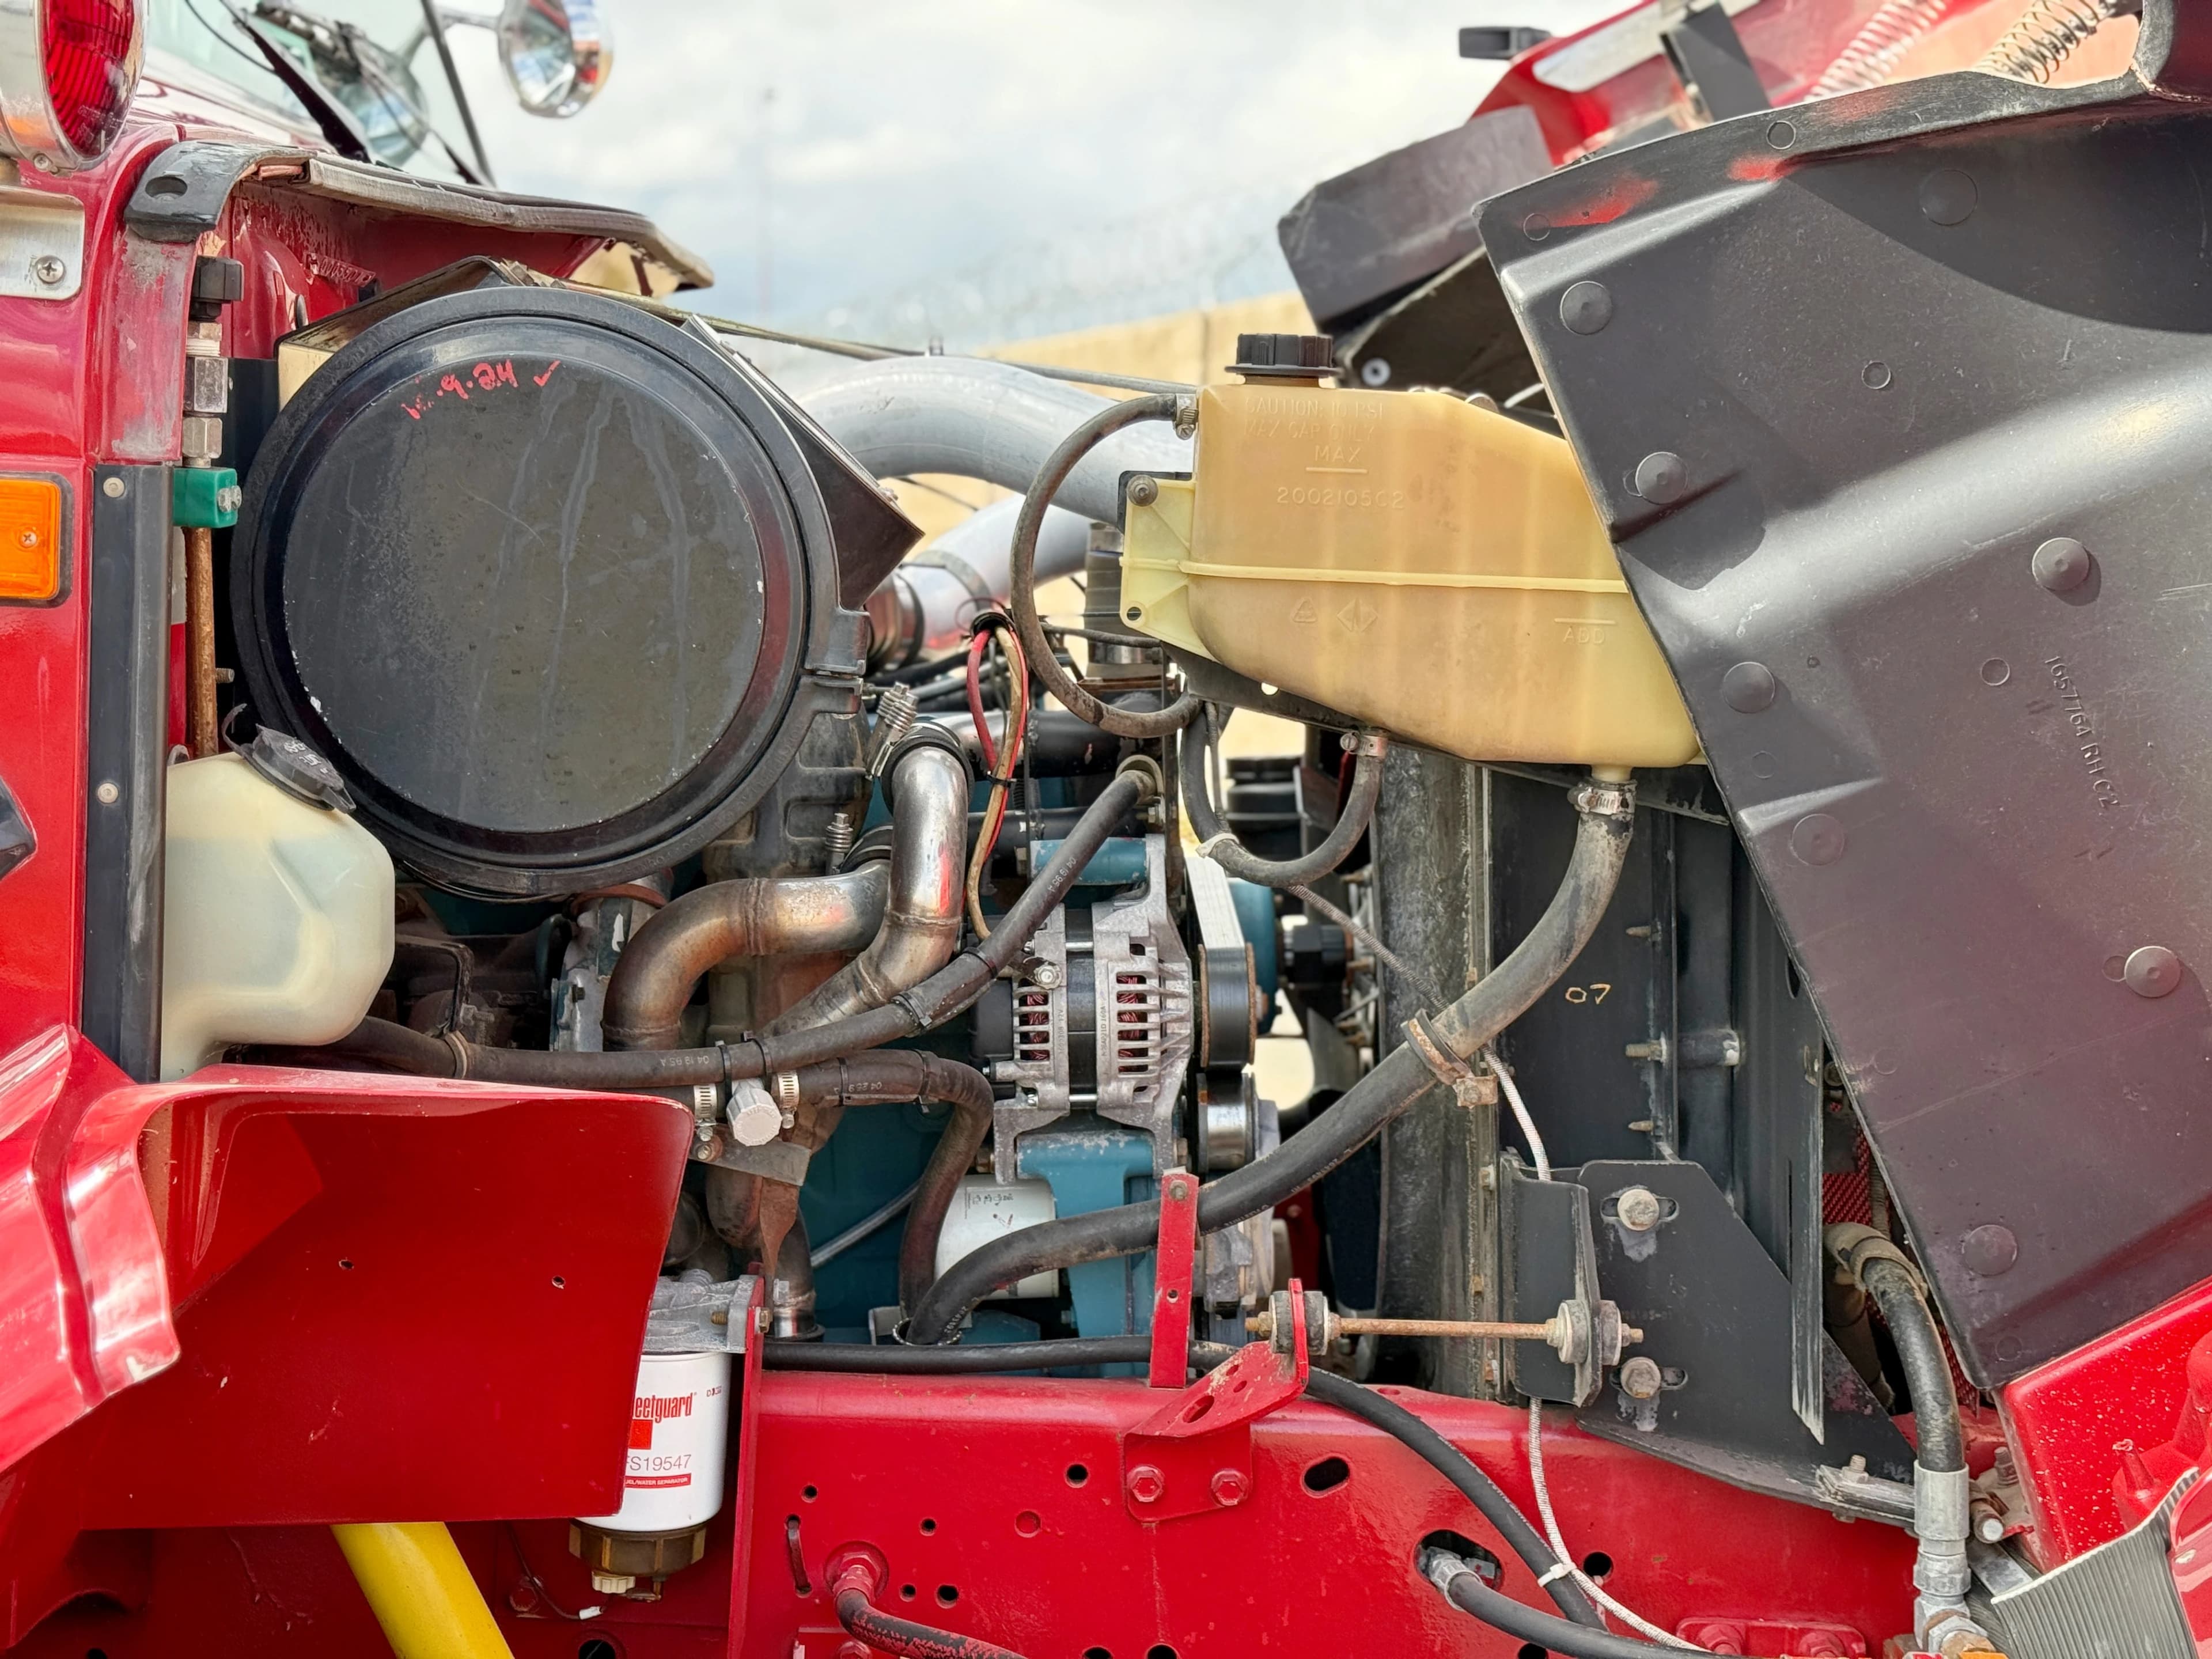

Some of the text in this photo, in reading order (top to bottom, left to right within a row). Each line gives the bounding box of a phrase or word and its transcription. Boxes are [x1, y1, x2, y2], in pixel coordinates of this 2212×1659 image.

[1244, 396, 1383, 419] CAUTION: 10 PSI
[1289, 421, 1321, 438] CAP
[1315, 445, 1361, 463] MAX
[1277, 487, 1406, 510] 2002105C2
[1562, 627, 1605, 645] ADD
[2081, 742, 2106, 774] RH
[1565, 983, 1611, 1005] 07
[634, 1392, 692, 1424] eetguard
